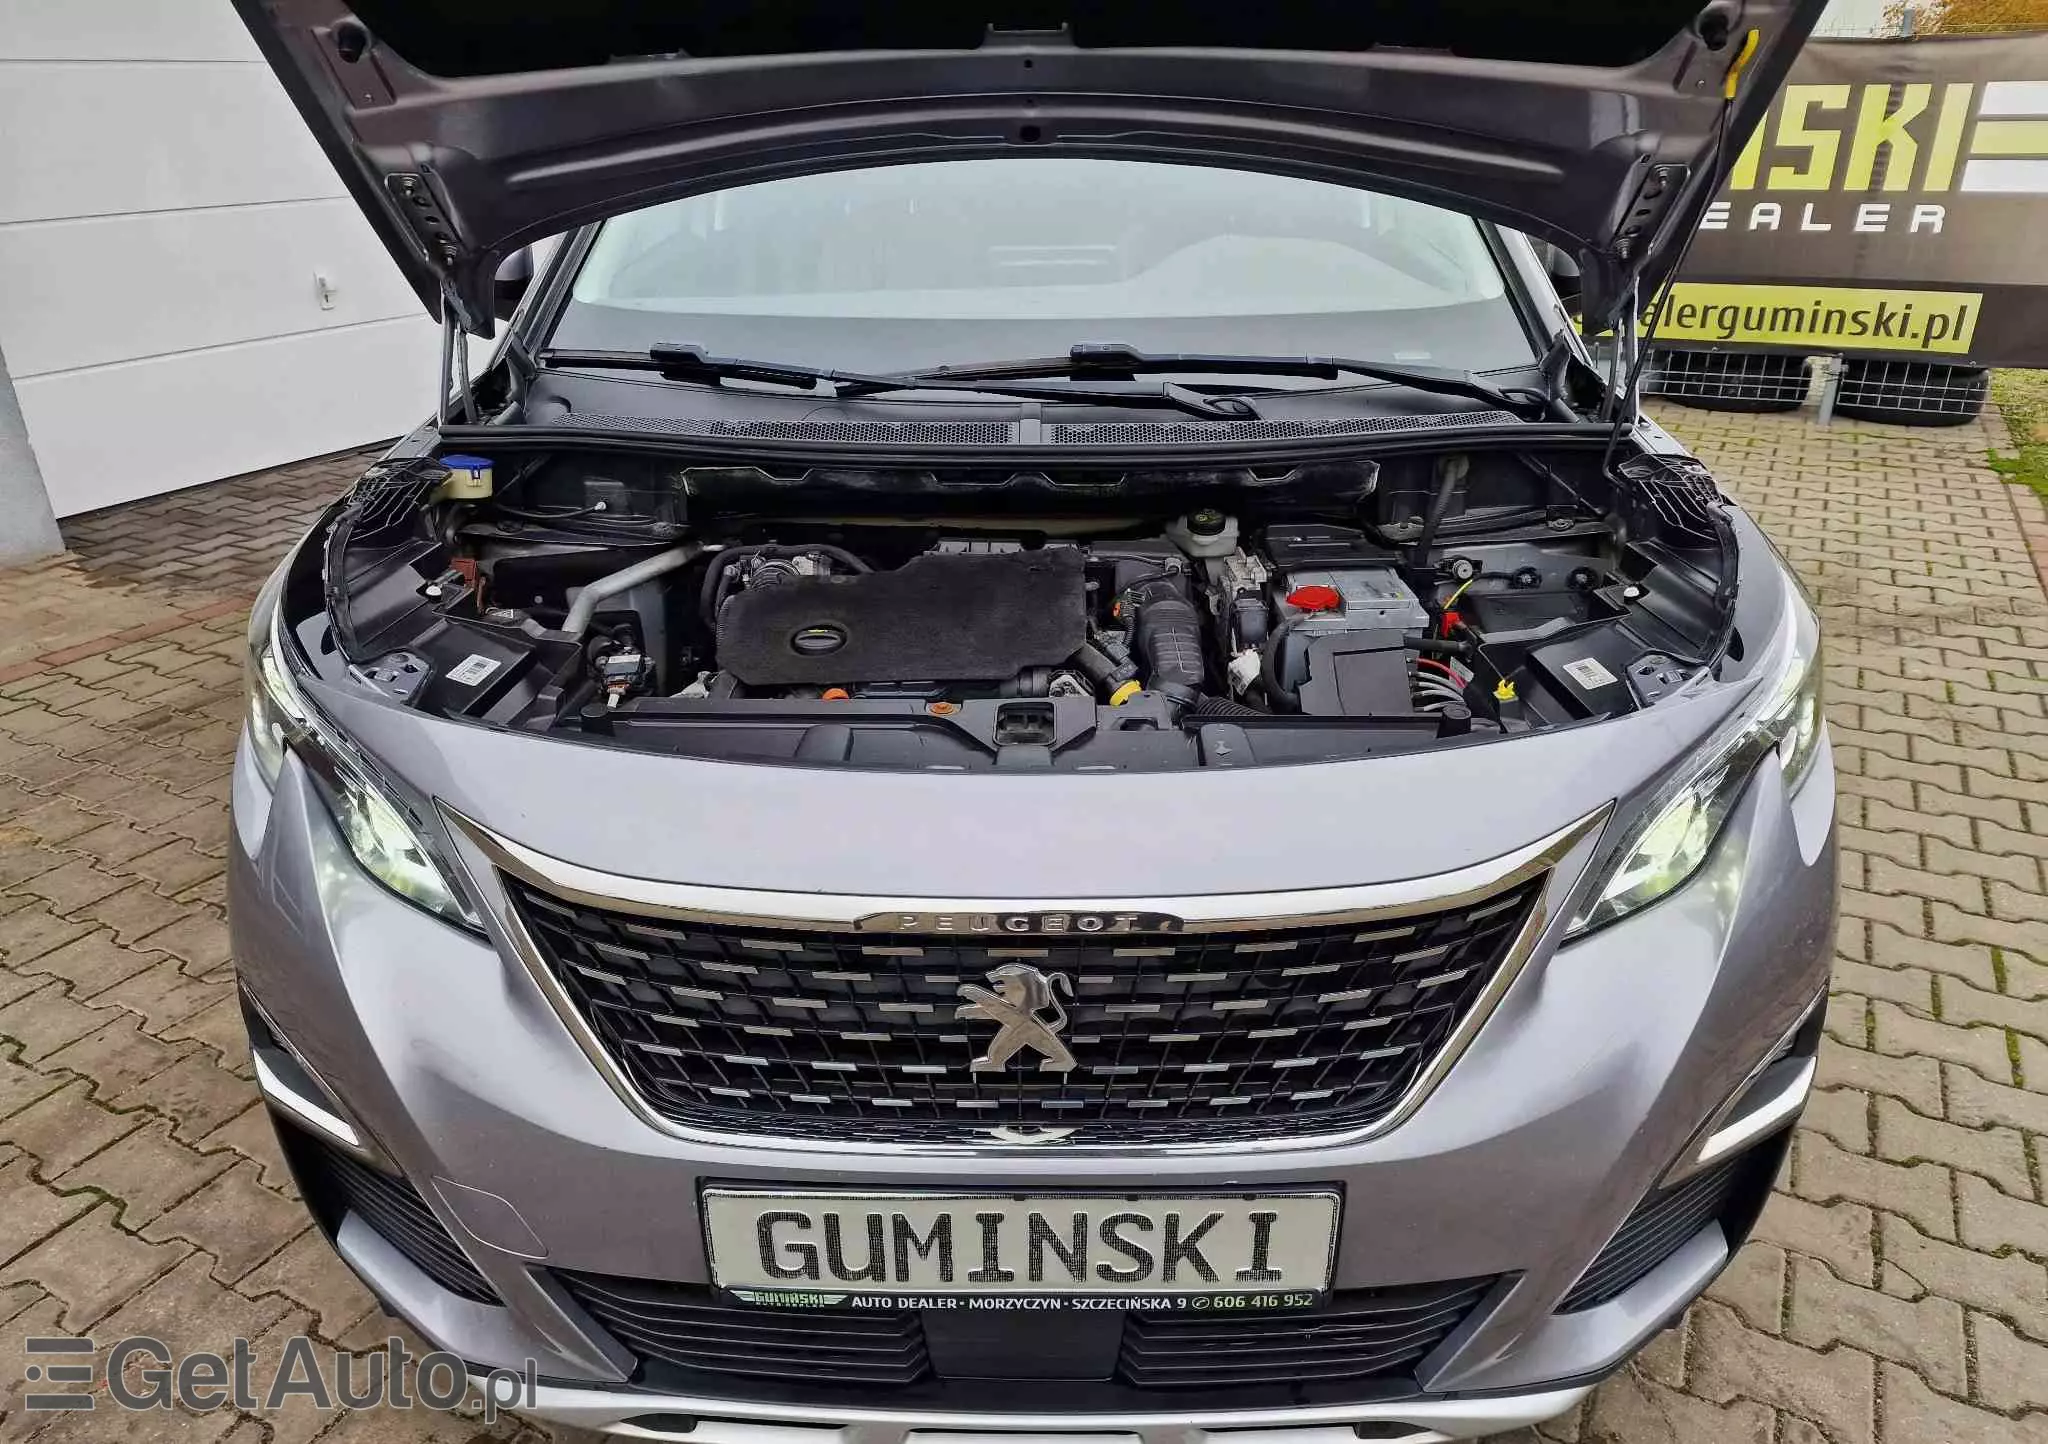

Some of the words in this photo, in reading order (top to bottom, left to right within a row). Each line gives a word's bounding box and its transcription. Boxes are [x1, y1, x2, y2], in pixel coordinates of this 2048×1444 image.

[899, 914, 1138, 932] PEUGEOT
[757, 1210, 1283, 1283] GUMINSKI
[852, 1296, 893, 1308] AUTO
[898, 1297, 957, 1309] DEALER
[969, 1298, 1061, 1310] MORZYCZYN
[1072, 1296, 1172, 1310] SZCZECIŃSKA
[1177, 1297, 1187, 1310] 9
[1213, 1296, 1246, 1308] 606
[1251, 1295, 1278, 1307] 416
[1284, 1293, 1313, 1306] 952
